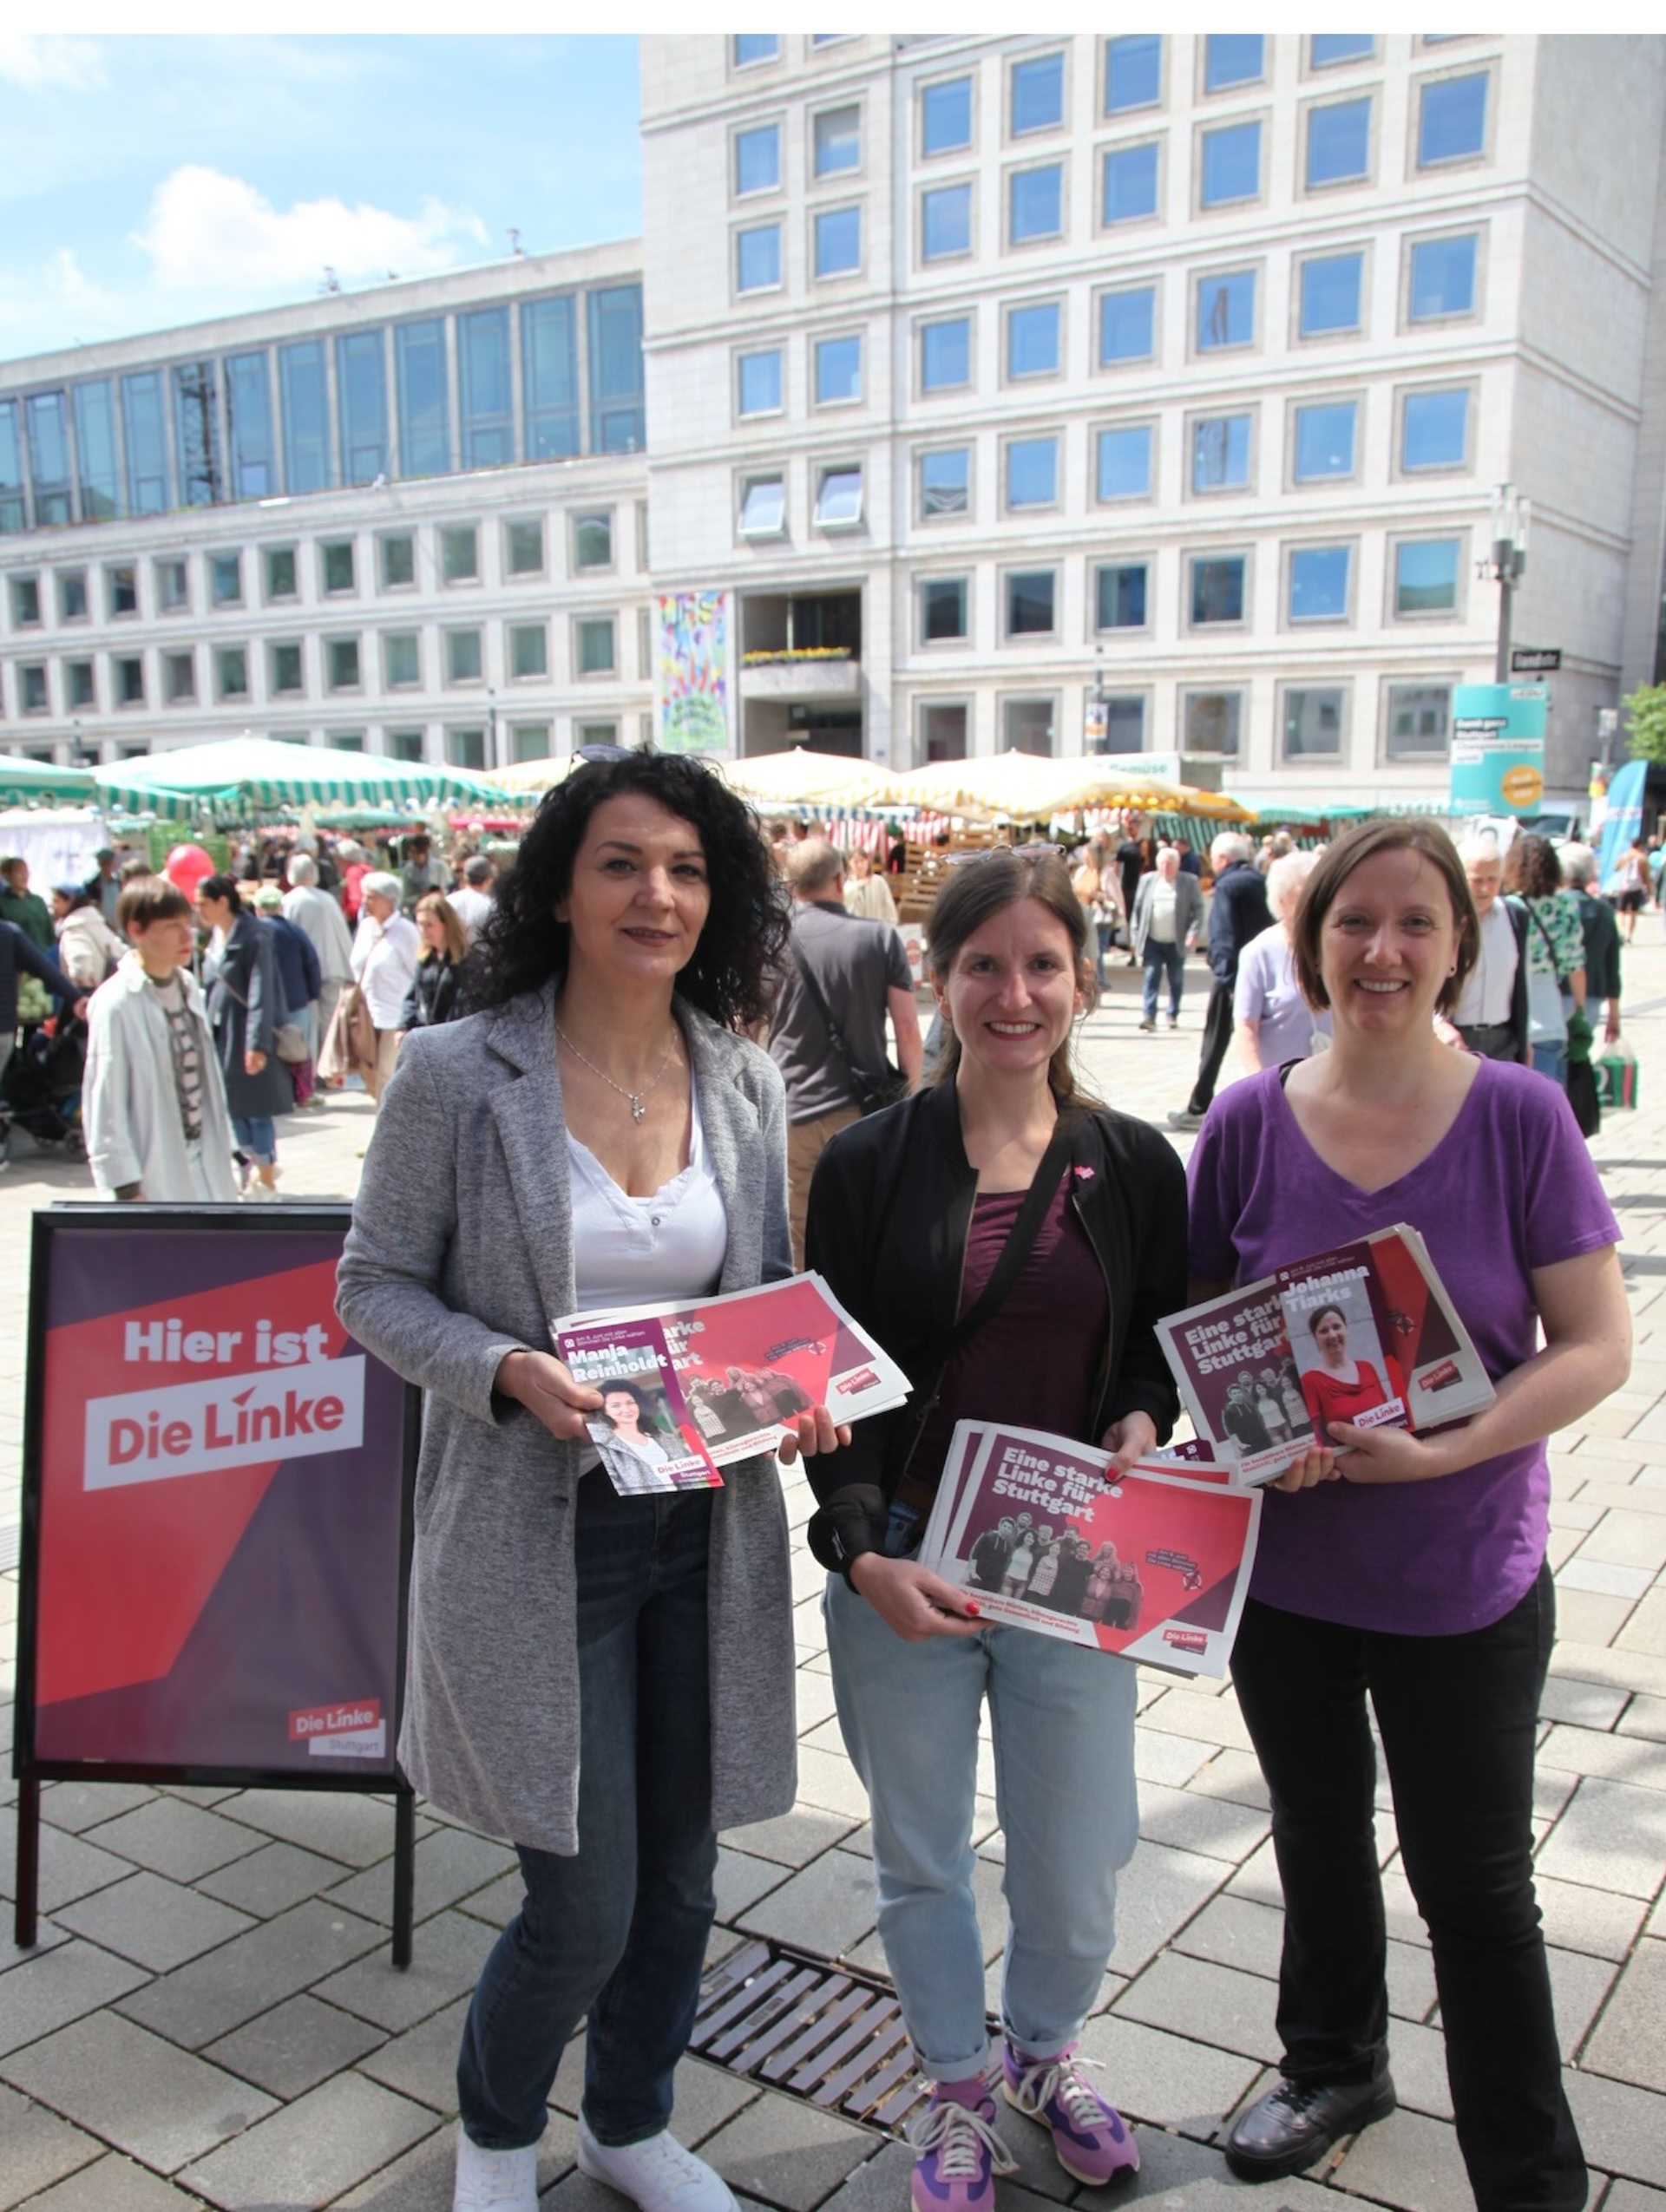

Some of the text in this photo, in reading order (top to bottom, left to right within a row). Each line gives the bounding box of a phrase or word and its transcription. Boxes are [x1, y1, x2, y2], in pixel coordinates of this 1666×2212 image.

[1283, 1265, 1370, 1299] Johanna
[1284, 1286, 1353, 1312] Tiarks
[662, 1320, 705, 1339] arke
[1184, 1294, 1282, 1346] Eine star
[124, 1317, 329, 1365] Hier ist
[567, 1344, 628, 1365] Manja
[666, 1338, 688, 1355] ür
[1190, 1316, 1282, 1362] Linke für
[1197, 1333, 1283, 1376] Stuttgar
[572, 1353, 668, 1383] Reinholdt
[108, 1385, 344, 1466] Die Linke
[1359, 1415, 1375, 1427] Die
[1375, 1404, 1400, 1420] Linke
[657, 1458, 702, 1475] Die Linke
[1003, 1446, 1124, 1499] Eine starke
[997, 1463, 1095, 1505] Linke für
[992, 1478, 1095, 1523] Stuttgart
[296, 1708, 374, 1733] Die Linke
[329, 1738, 379, 1753] Stuttgart
